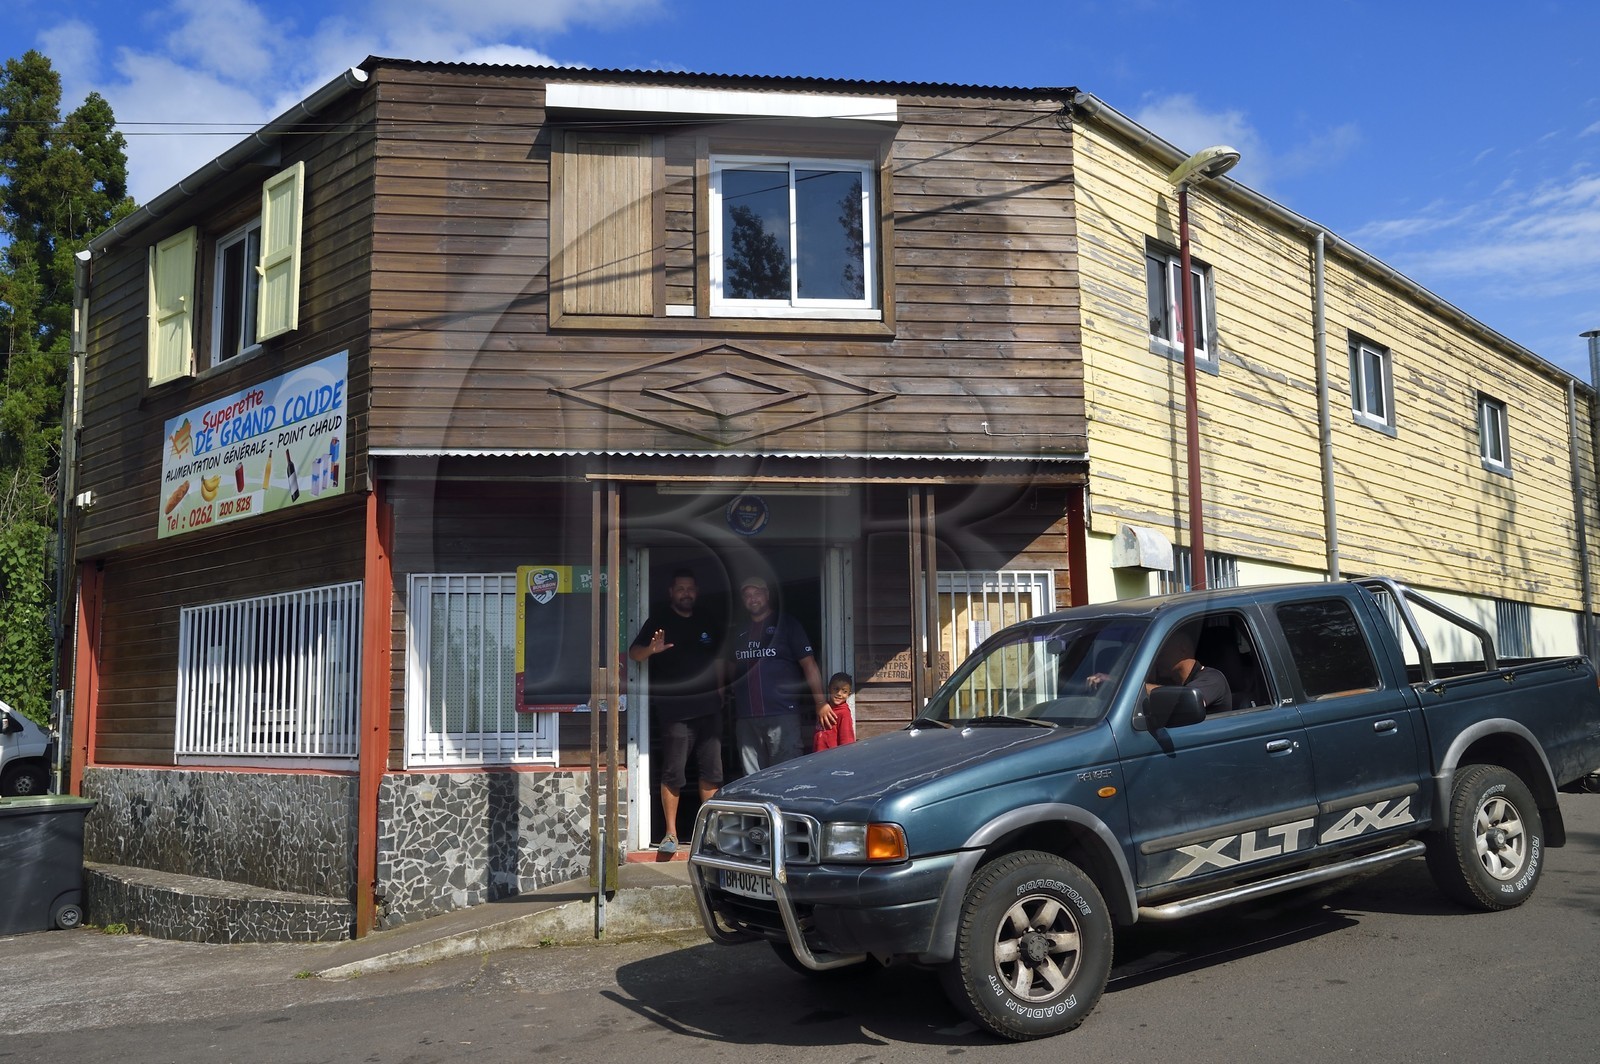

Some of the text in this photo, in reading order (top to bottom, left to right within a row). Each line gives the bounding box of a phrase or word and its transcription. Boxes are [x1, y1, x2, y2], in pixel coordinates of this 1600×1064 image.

[194, 379, 344, 456] DE GRAND COUDE
[202, 388, 264, 433] Superette
[165, 453, 221, 483] ALIMENTATION
[223, 439, 267, 465] GÉNÉRALE
[277, 425, 306, 449] POINT
[308, 415, 342, 438] CHAUD
[189, 504, 213, 527] 0262
[219, 501, 233, 516] 200
[735, 647, 777, 660] Emirates
[1076, 768, 1112, 782] RANGER
[1168, 818, 1314, 881] XLT
[1016, 878, 1092, 916] ROADSTONE
[1006, 994, 1078, 1019] ROADIAN
